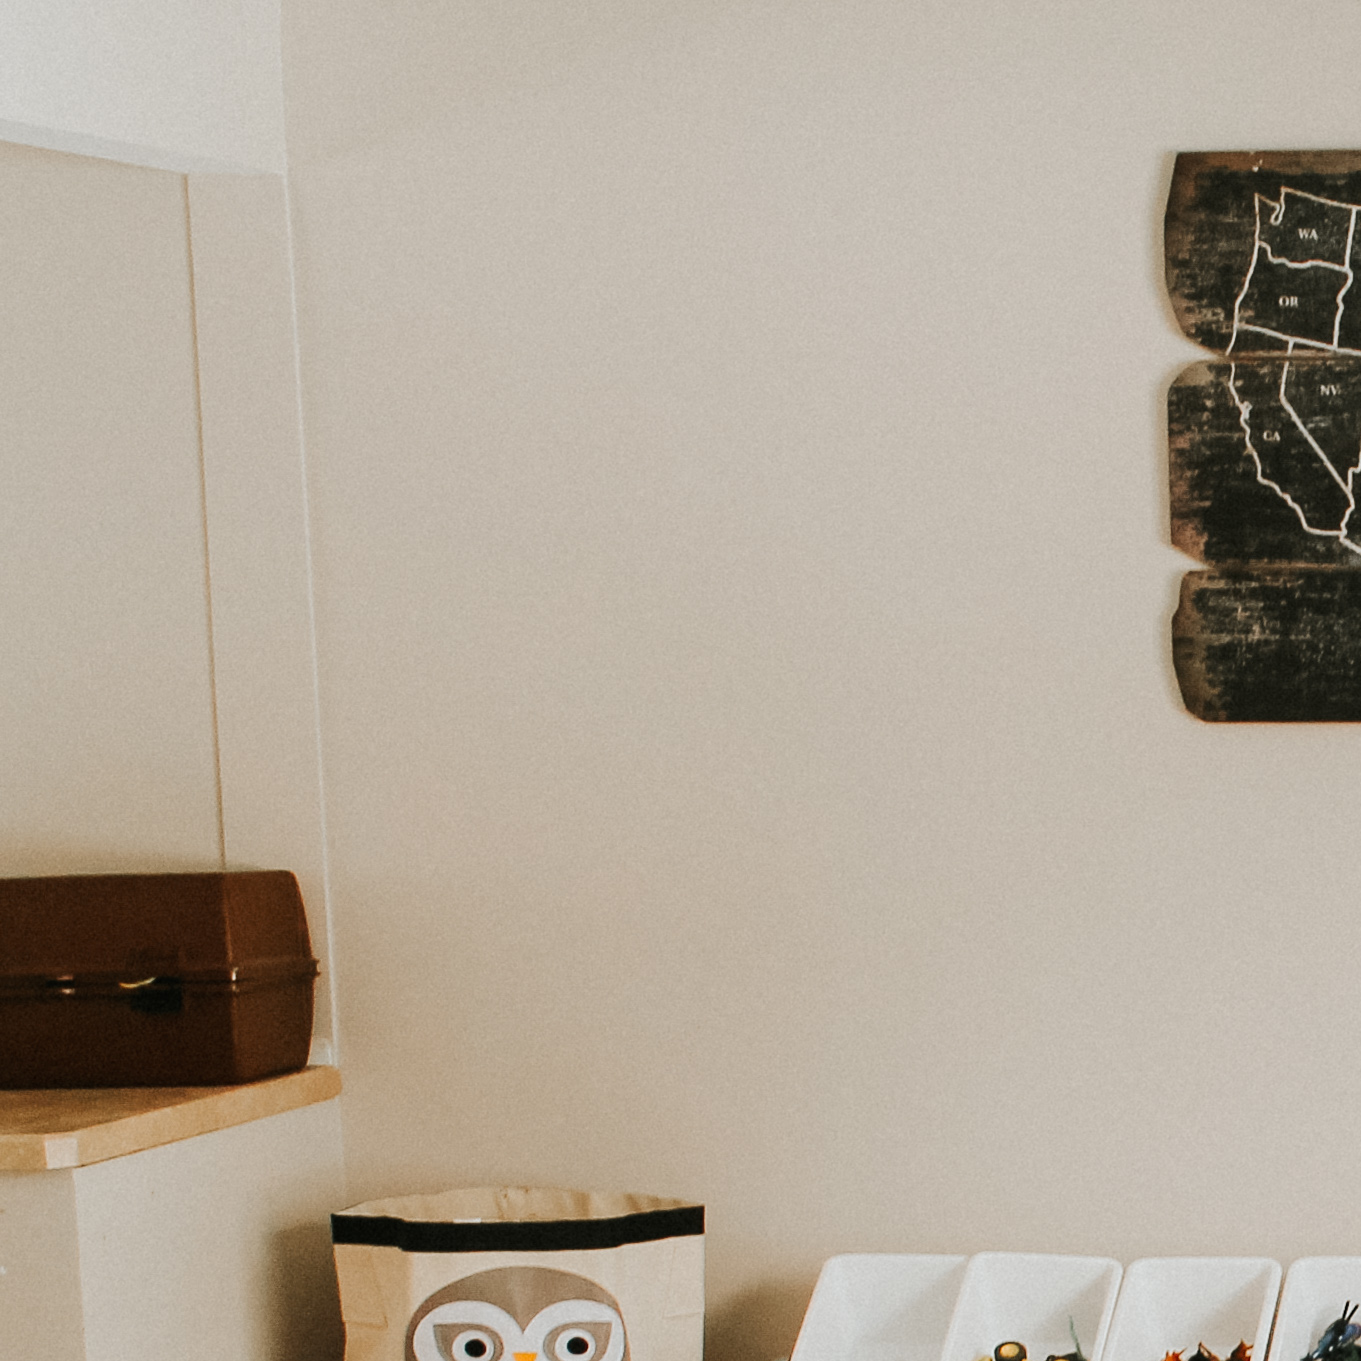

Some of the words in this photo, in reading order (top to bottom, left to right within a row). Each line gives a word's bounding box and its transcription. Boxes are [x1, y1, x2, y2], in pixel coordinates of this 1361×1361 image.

[1298, 228, 1319, 241] WA
[1278, 295, 1299, 307] OR
[1320, 384, 1340, 396] NV
[1262, 430, 1281, 442] CA
